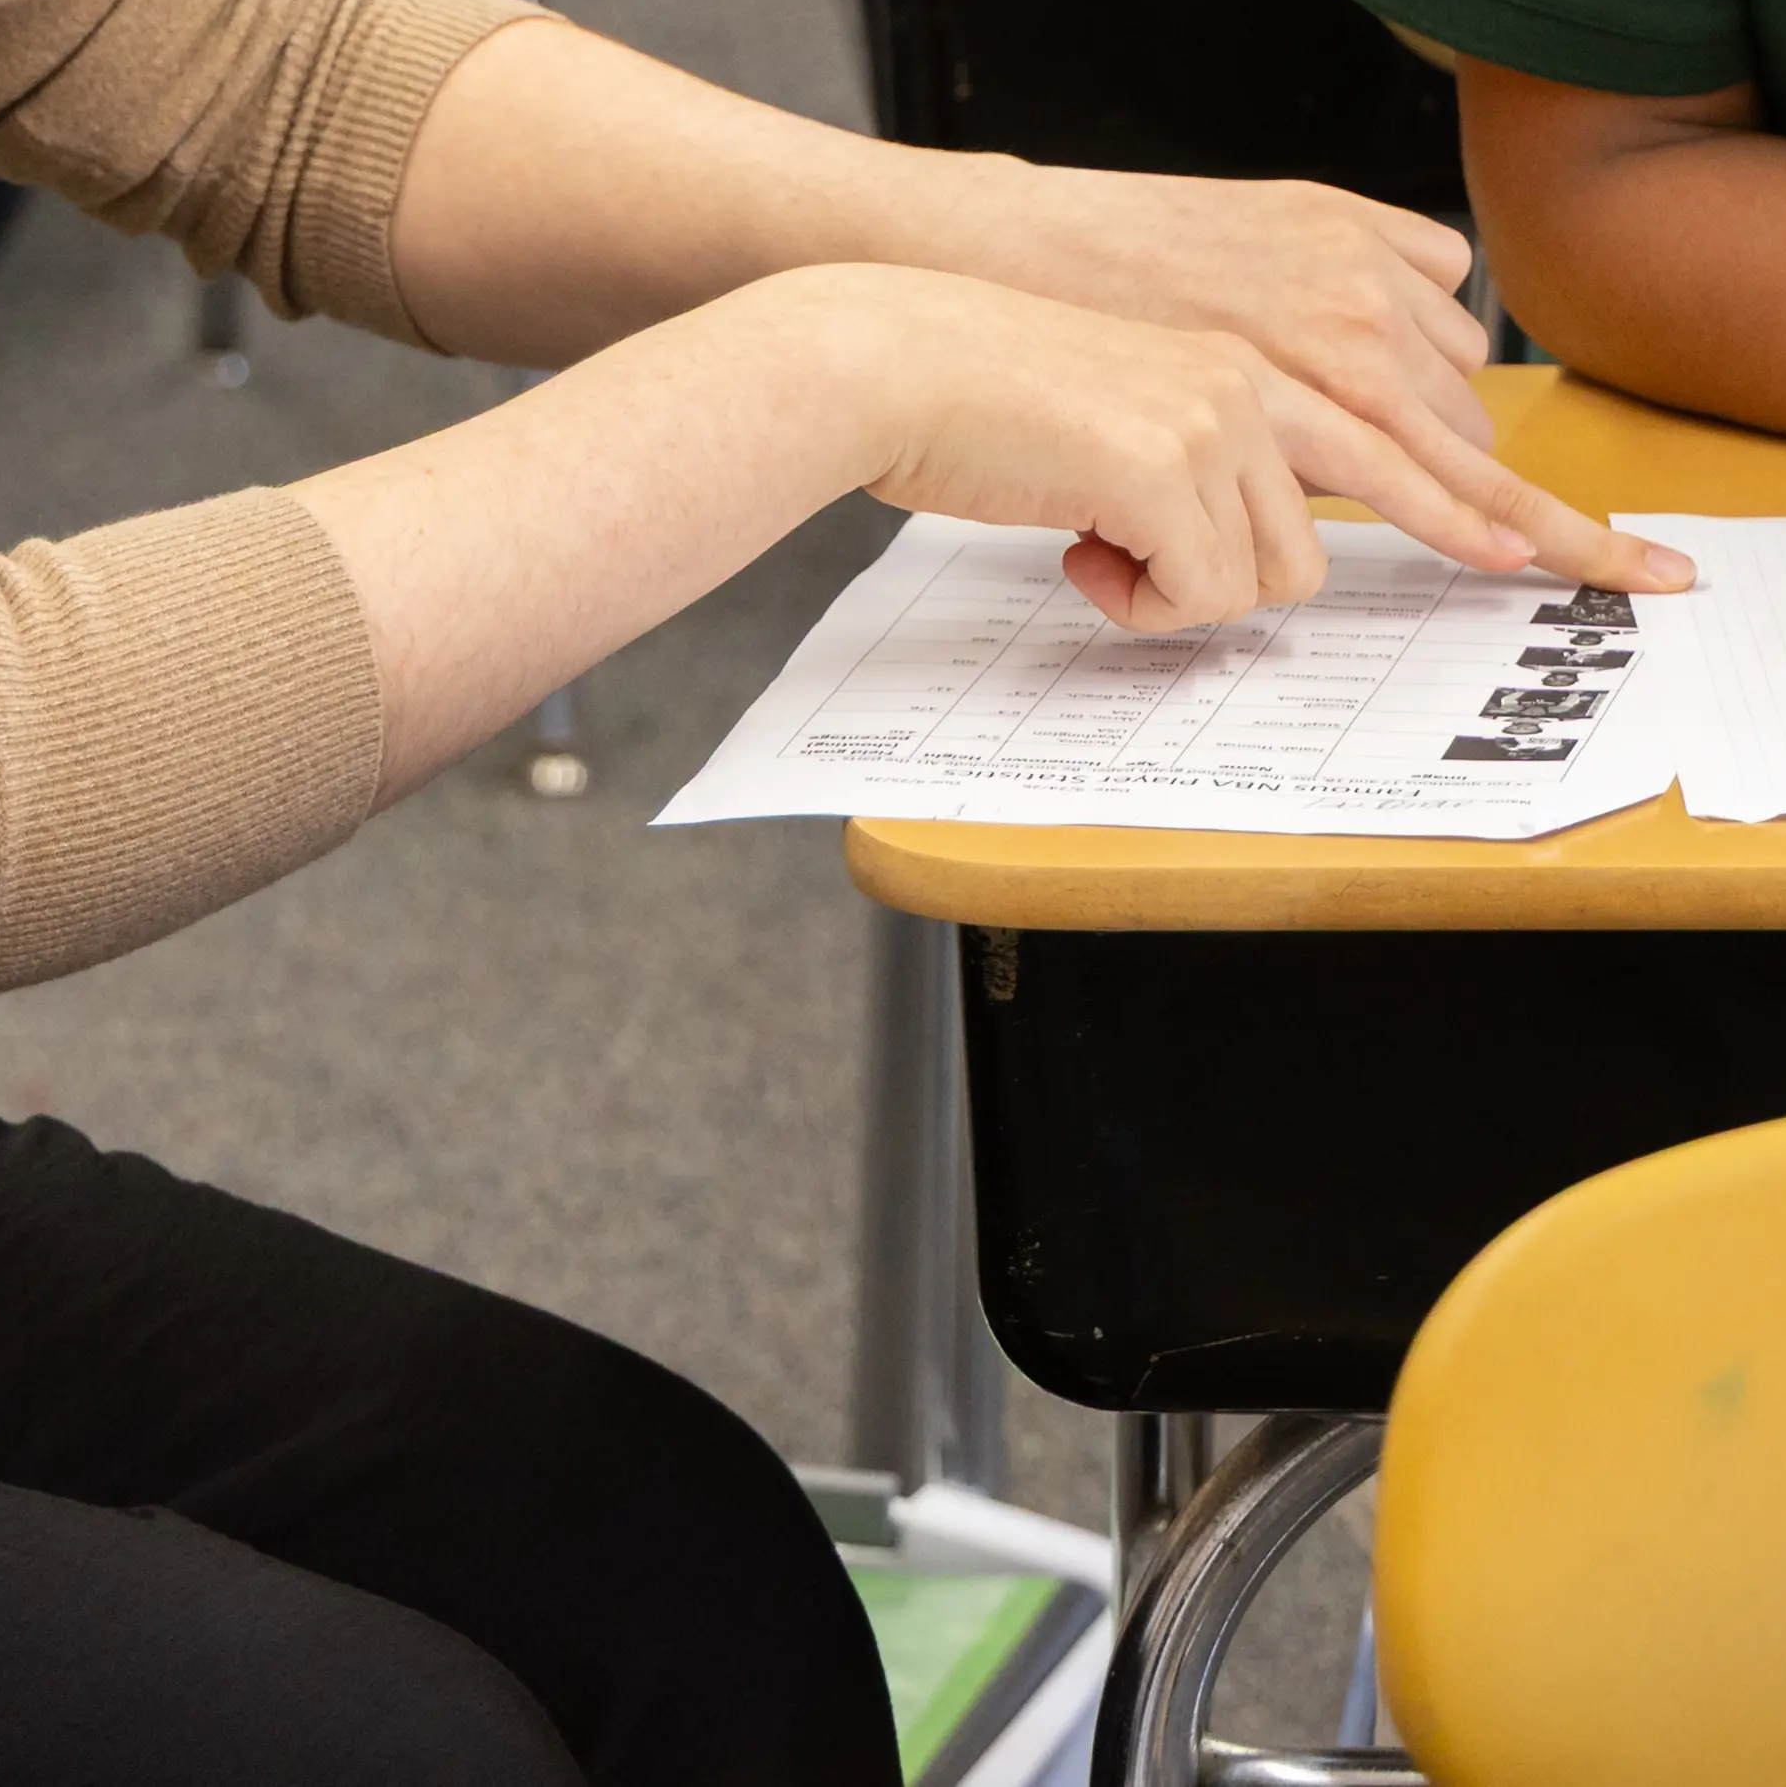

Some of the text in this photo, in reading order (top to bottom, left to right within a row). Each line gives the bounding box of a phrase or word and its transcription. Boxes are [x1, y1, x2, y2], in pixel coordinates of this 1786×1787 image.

[807, 734, 912, 742] percentage
[924, 752, 983, 762] Height
[1002, 757, 1102, 767] Hometown
[943, 770, 1421, 798] Famous NBA Player Statistics
